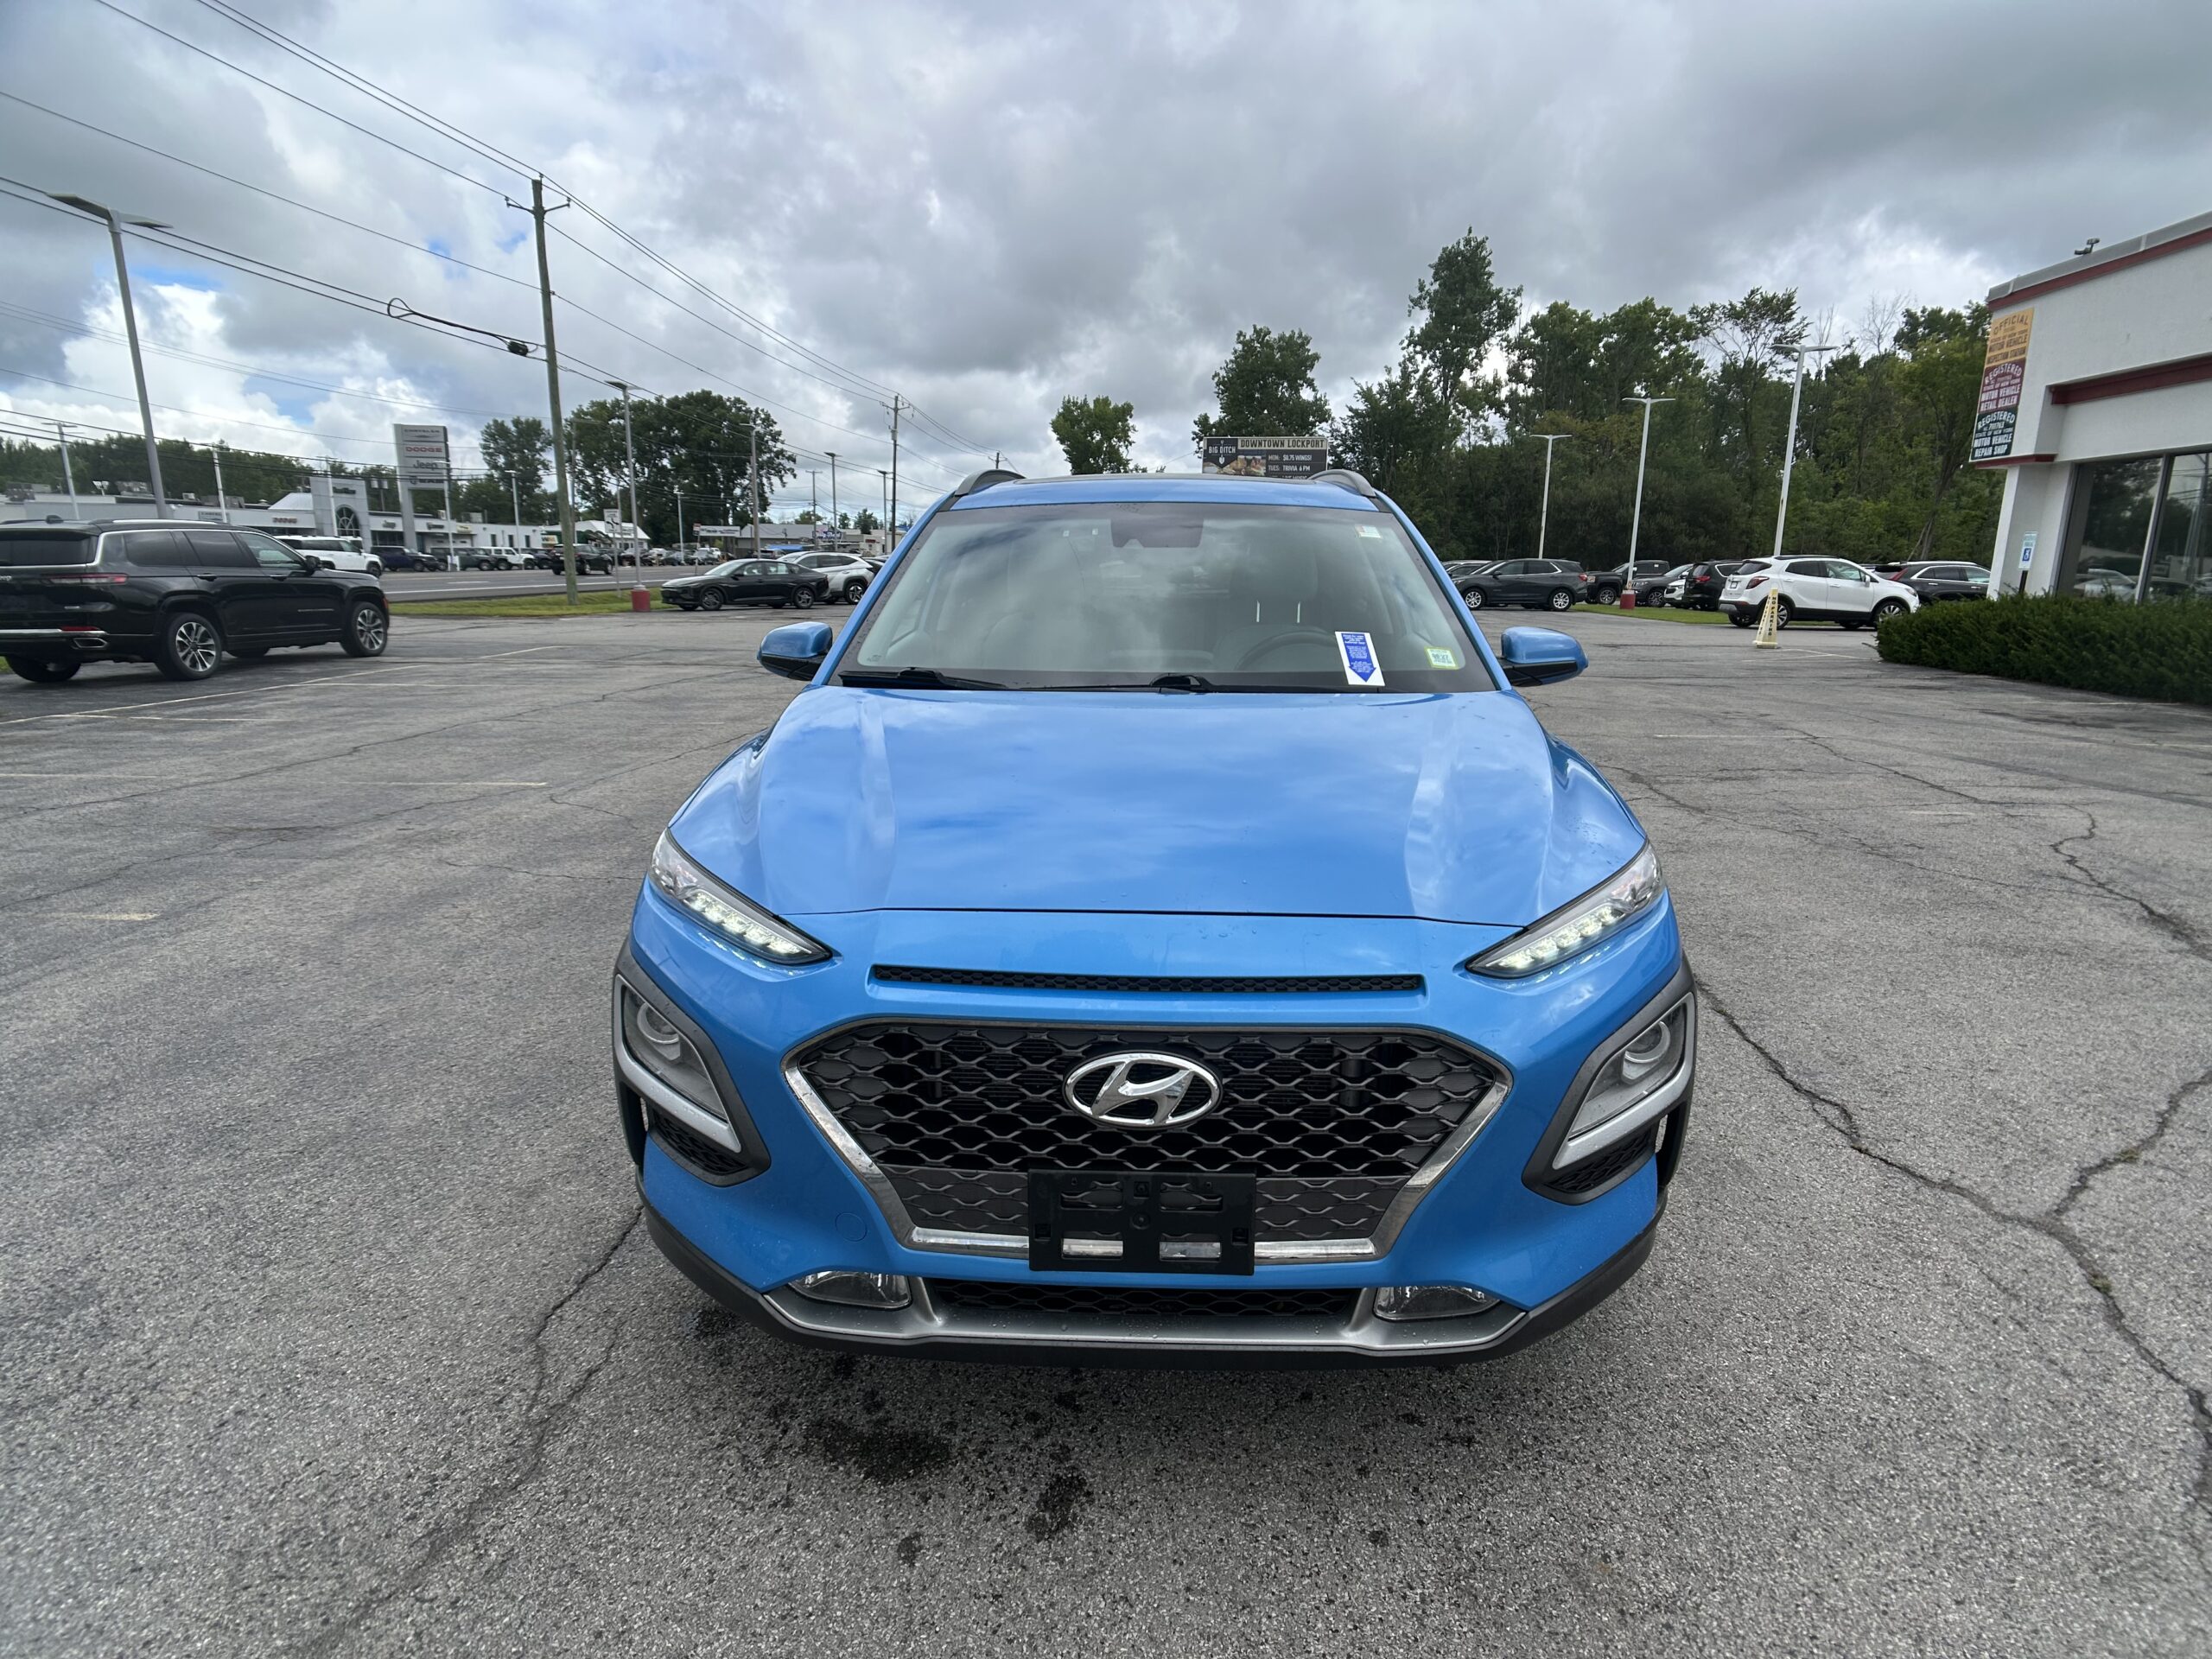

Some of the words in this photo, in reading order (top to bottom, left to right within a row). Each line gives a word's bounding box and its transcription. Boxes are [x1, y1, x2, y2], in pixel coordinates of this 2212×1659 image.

[1993, 315, 2029, 335] OFFICIAL
[1989, 340, 2005, 353] MOTOR
[2005, 334, 2028, 347] VEHICLE
[1984, 363, 2022, 385] REGISTERED
[1980, 389, 1999, 402] MOTOR
[1999, 384, 2021, 397] VEHICLE
[1980, 399, 1997, 411] RETAIL
[1998, 395, 2018, 408] DEALER
[1977, 410, 2016, 430] REGISTERED
[1240, 439, 1285, 448] DOWNTOWN
[1287, 439, 1325, 448] LOCKPORT
[1974, 436, 1991, 448] MOTOR
[1992, 433, 2013, 445] VEHICLE
[1974, 446, 1993, 458] REPAIR
[1993, 444, 2008, 454] SHOP
[413, 460, 437, 471] Jeep
